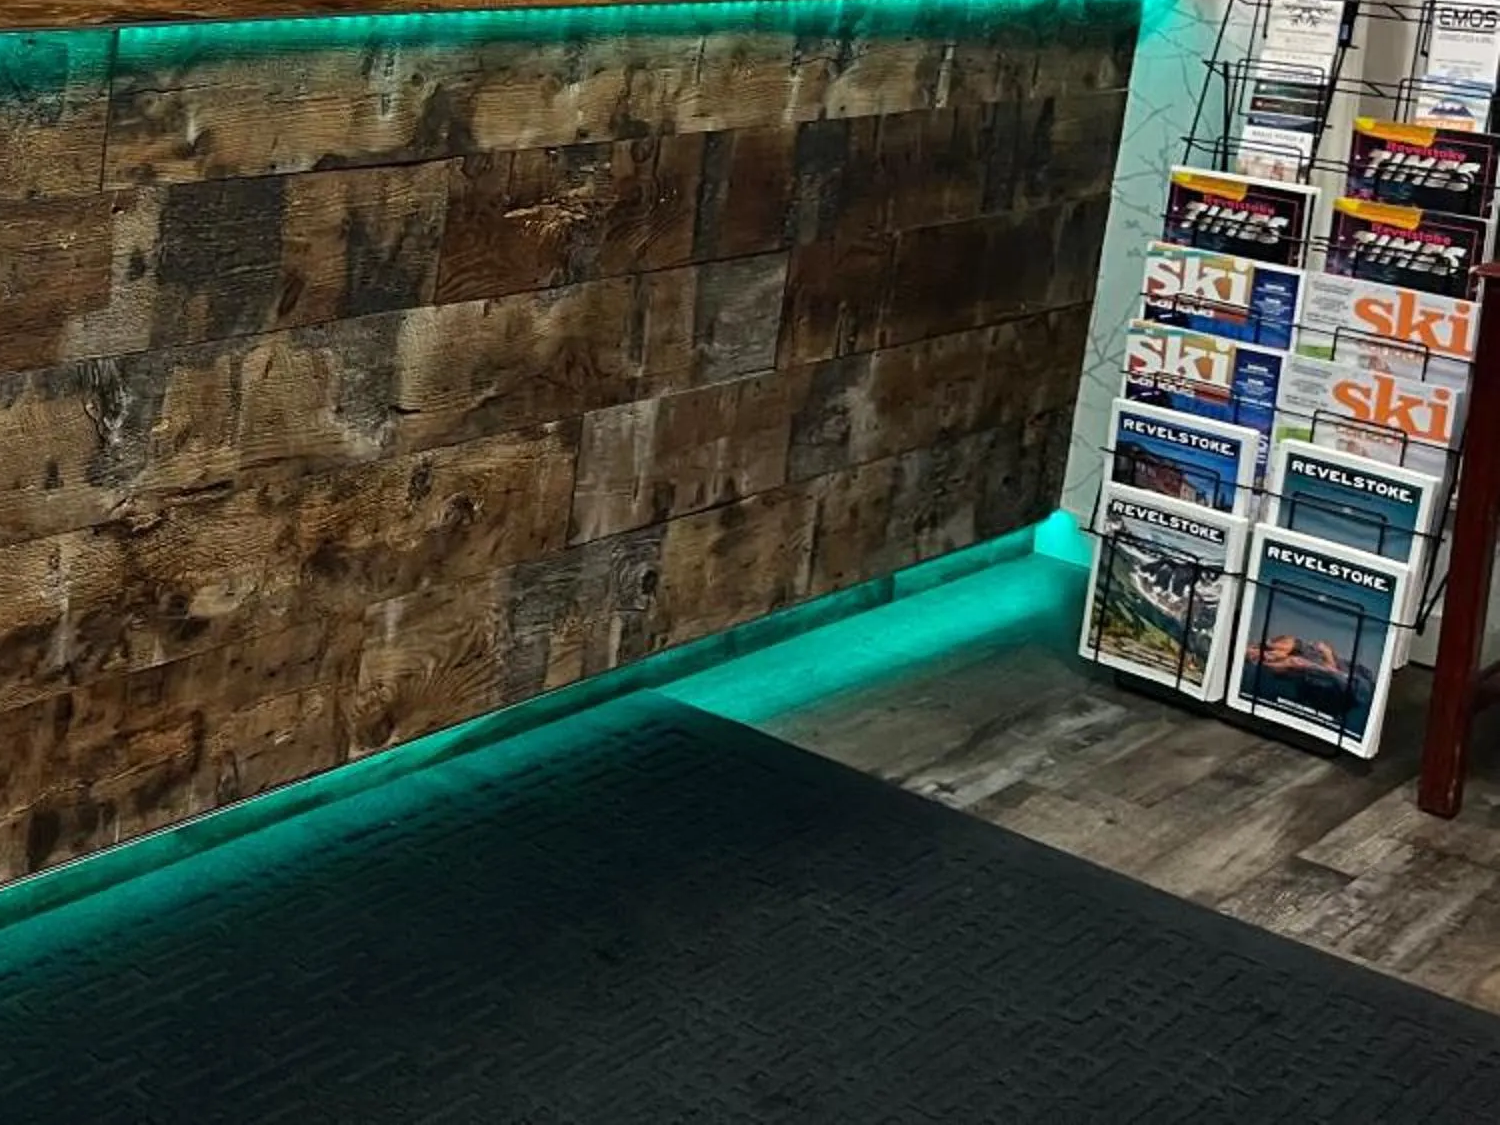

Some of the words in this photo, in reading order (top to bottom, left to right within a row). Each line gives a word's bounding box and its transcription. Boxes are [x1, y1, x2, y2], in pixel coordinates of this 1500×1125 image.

[1363, 148, 1481, 193] TIMES
[1354, 290, 1474, 358] ski
[1332, 374, 1453, 444] ski
